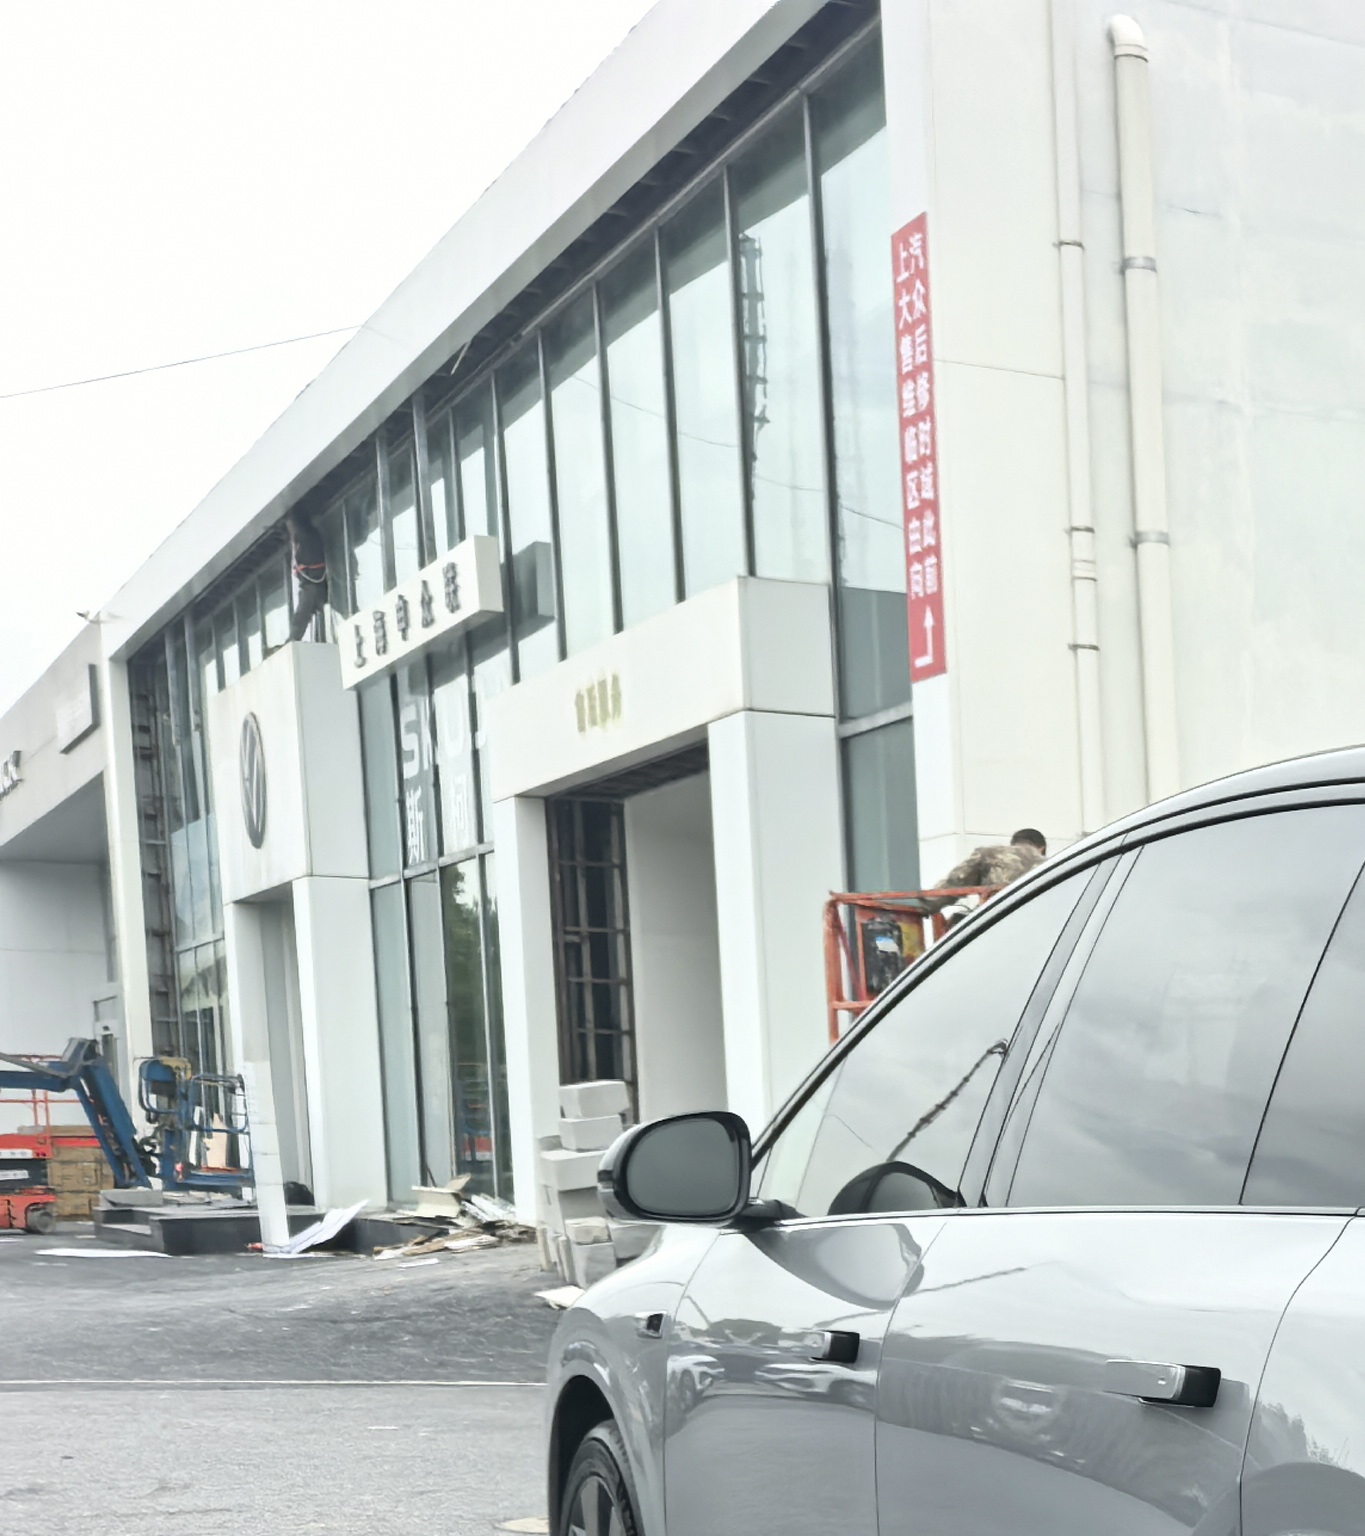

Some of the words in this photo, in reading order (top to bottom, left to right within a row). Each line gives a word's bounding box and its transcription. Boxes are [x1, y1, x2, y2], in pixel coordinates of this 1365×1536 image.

[896, 232, 925, 283] 上汽
[898, 278, 927, 329] 大众
[900, 324, 928, 374] 售后
